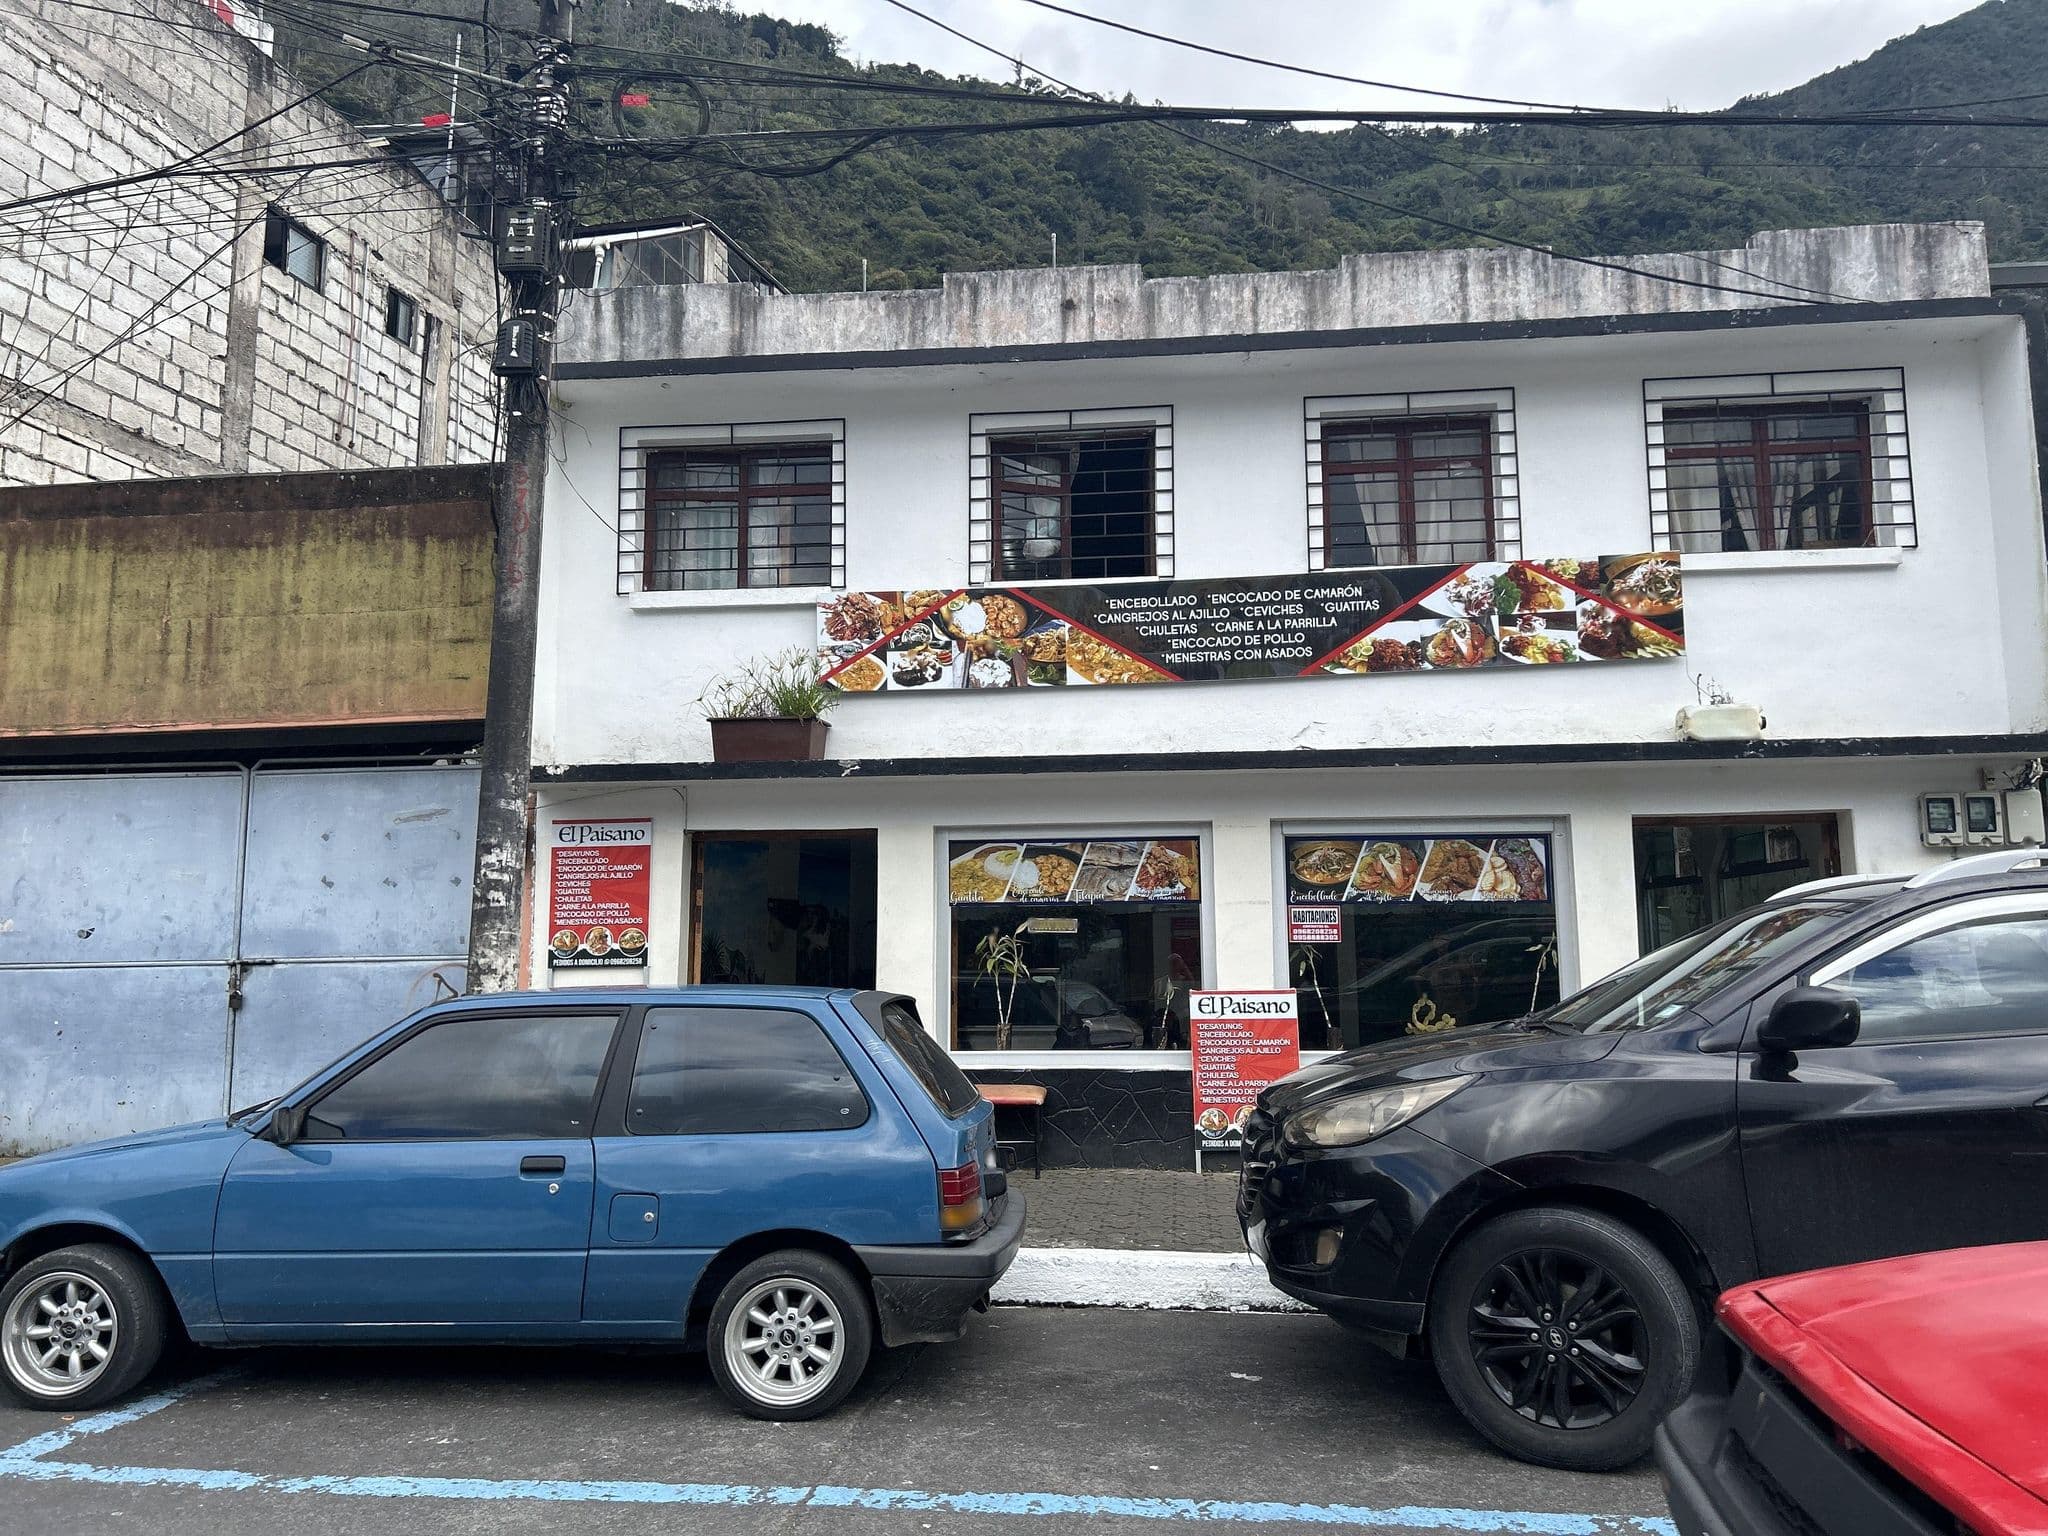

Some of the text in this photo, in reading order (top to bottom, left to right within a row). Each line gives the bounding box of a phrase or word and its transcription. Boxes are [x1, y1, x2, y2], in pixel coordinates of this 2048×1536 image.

[1109, 584, 1363, 609] ENCEBOLLADO ENCOCADO DE CAMARÓN
[1098, 599, 1380, 624] CANGREJOS AL AJILLO CEVICHES GUATITAS
[1139, 616, 1338, 637] CHULETAS CARNE A LA PARRILLA
[1172, 632, 1305, 650] ENCOCADO DE POLLO
[1165, 646, 1313, 664] MENESTRAS CON ASADOS
[558, 825, 645, 846] El Paisano
[558, 850, 600, 858] DESAYUNOS
[558, 857, 610, 865] ENCEBOLLADO
[558, 865, 597, 873] ENCOCADO
[608, 863, 643, 871] CAMARÓN
[610, 871, 634, 879] AJILLO
[557, 880, 591, 888] CEVICHES
[557, 895, 593, 903] CHULETAS
[556, 903, 581, 911] CARNE
[1292, 910, 1337, 923] HABITACIONES
[556, 918, 598, 926] MENESTRAS
[613, 917, 643, 925] ASADOS
[1198, 996, 1291, 1019] El Paisano
[1253, 1037, 1291, 1046] CAMARÓN
[1200, 1055, 1236, 1063] CEVICHES
[1200, 1063, 1236, 1071] GUATITAS
[1202, 1088, 1244, 1096] ENCOCADO
[1244, 1088, 1255, 1096] DE
[1202, 1096, 1247, 1104] MENESTRAS
